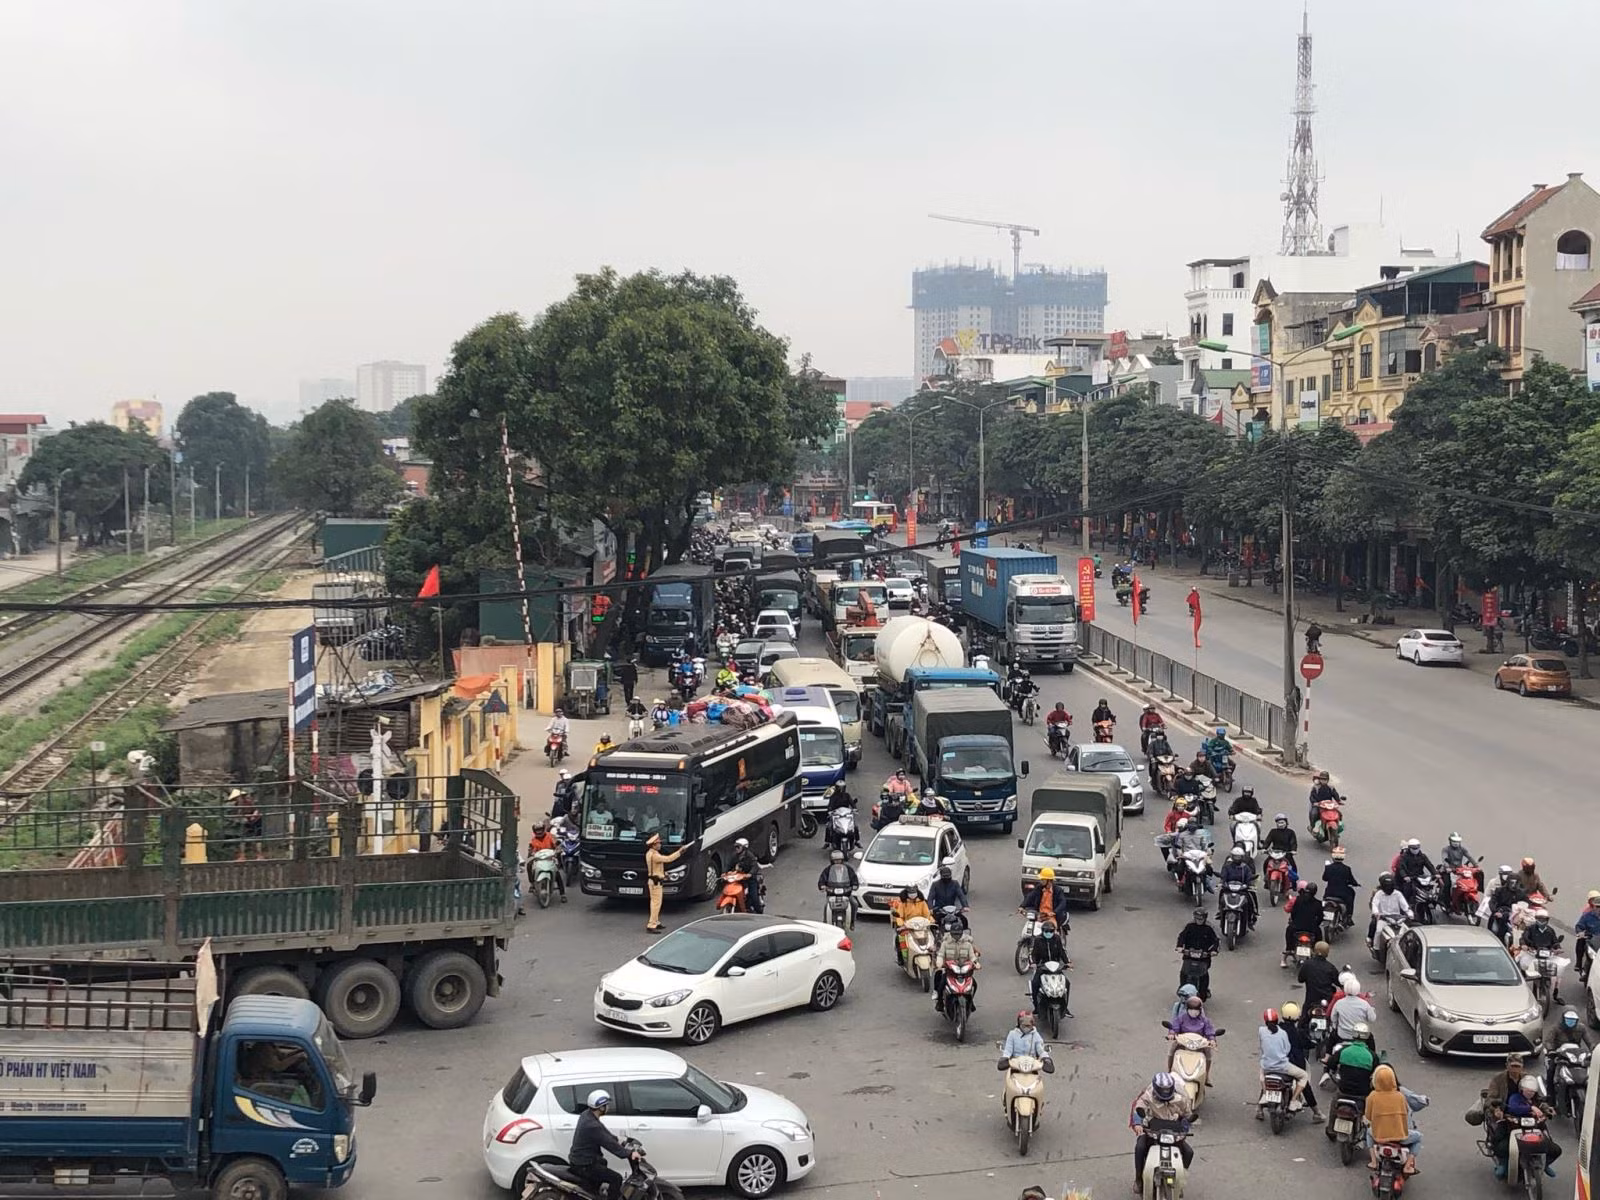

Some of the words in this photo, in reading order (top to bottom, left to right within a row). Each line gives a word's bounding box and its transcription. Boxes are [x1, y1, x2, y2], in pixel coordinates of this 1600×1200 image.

[979, 332, 1042, 351] TPBank
[36, 1062, 48, 1078] HT
[50, 1060, 71, 1081] VIỆT
[73, 1063, 96, 1079] NAM
